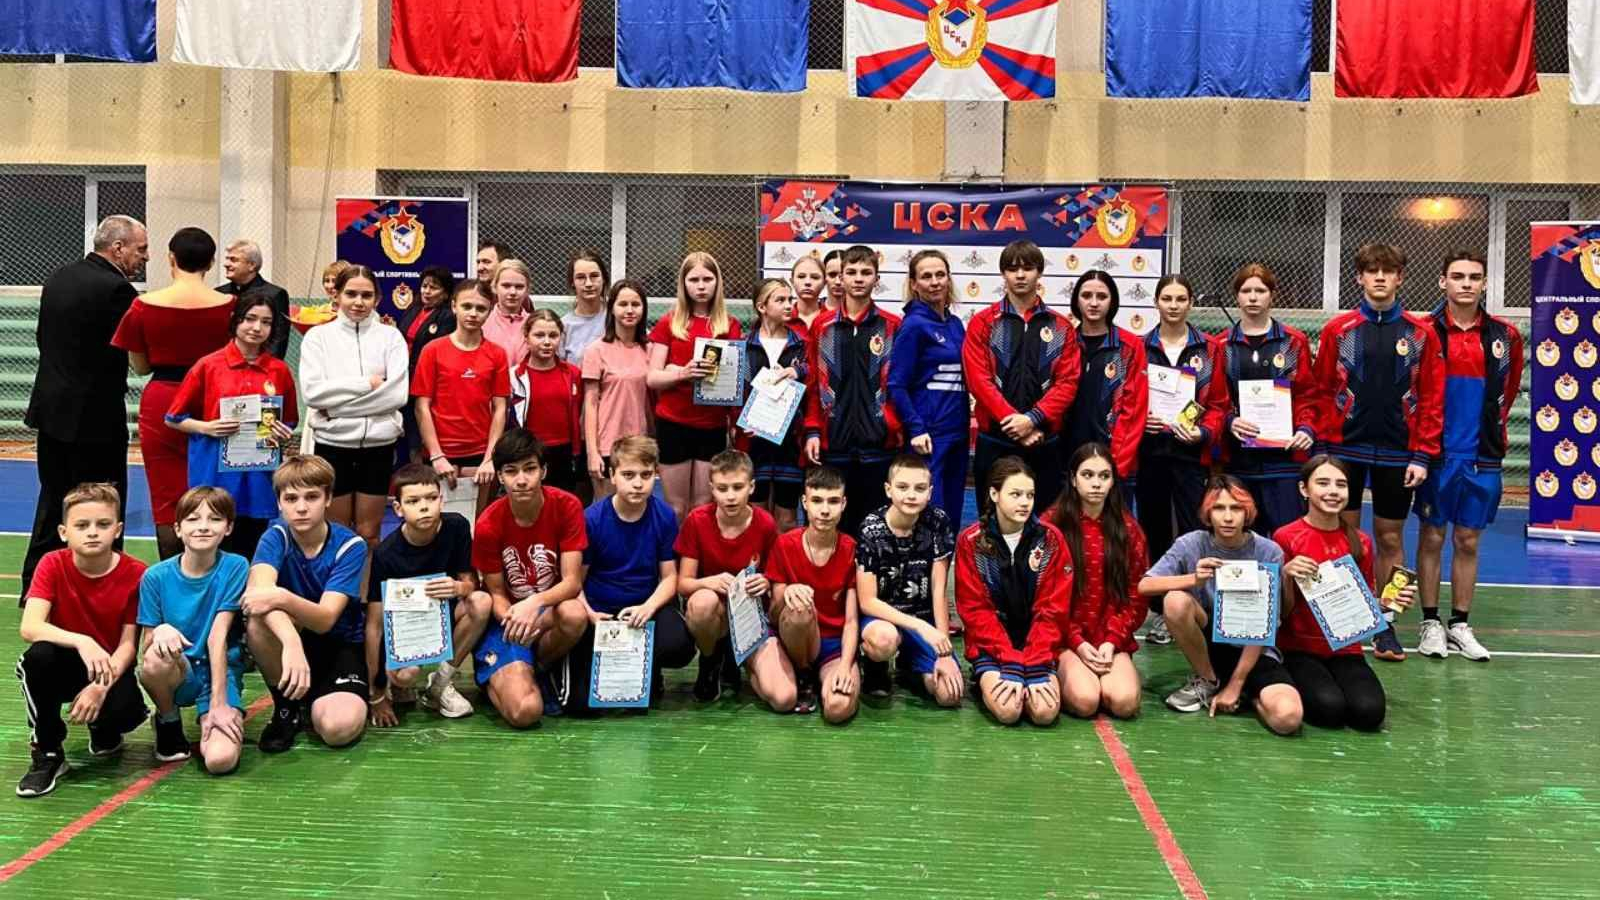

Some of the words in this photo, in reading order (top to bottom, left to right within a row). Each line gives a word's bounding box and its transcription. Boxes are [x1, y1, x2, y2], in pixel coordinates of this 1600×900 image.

[944, 24, 967, 48] ЦСКА
[893, 202, 1028, 233] ЦСКА
[1535, 295, 1584, 303] ЦЕНТРАЛЬНЫЙ
